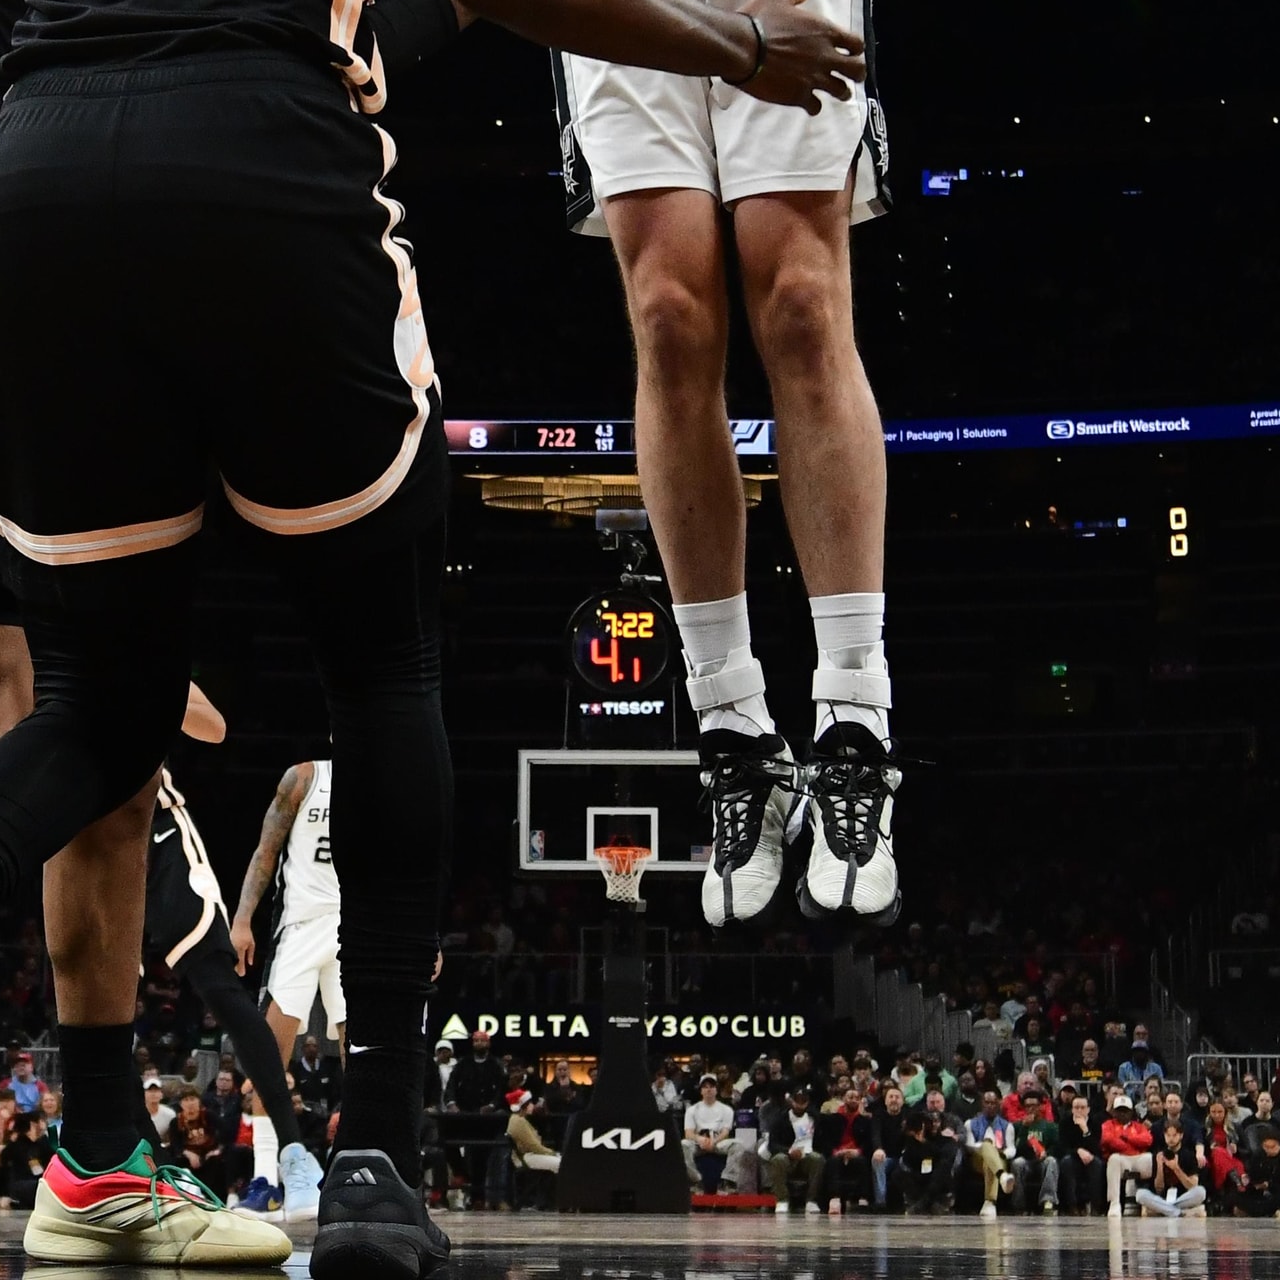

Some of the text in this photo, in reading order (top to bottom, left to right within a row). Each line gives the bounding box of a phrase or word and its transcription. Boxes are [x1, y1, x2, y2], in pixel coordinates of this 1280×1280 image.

[595, 424, 614, 438] 4.3
[906, 430, 954, 442] Packaging
[962, 428, 1007, 439] Solutions
[1076, 417, 1191, 435] Smurfit Westrock
[469, 427, 488, 448] 8
[537, 428, 576, 448] 7:22
[595, 438, 614, 452] 1ST
[601, 612, 654, 638] 7:22
[602, 701, 664, 716] TISSOT
[478, 1015, 590, 1037] DELTA
